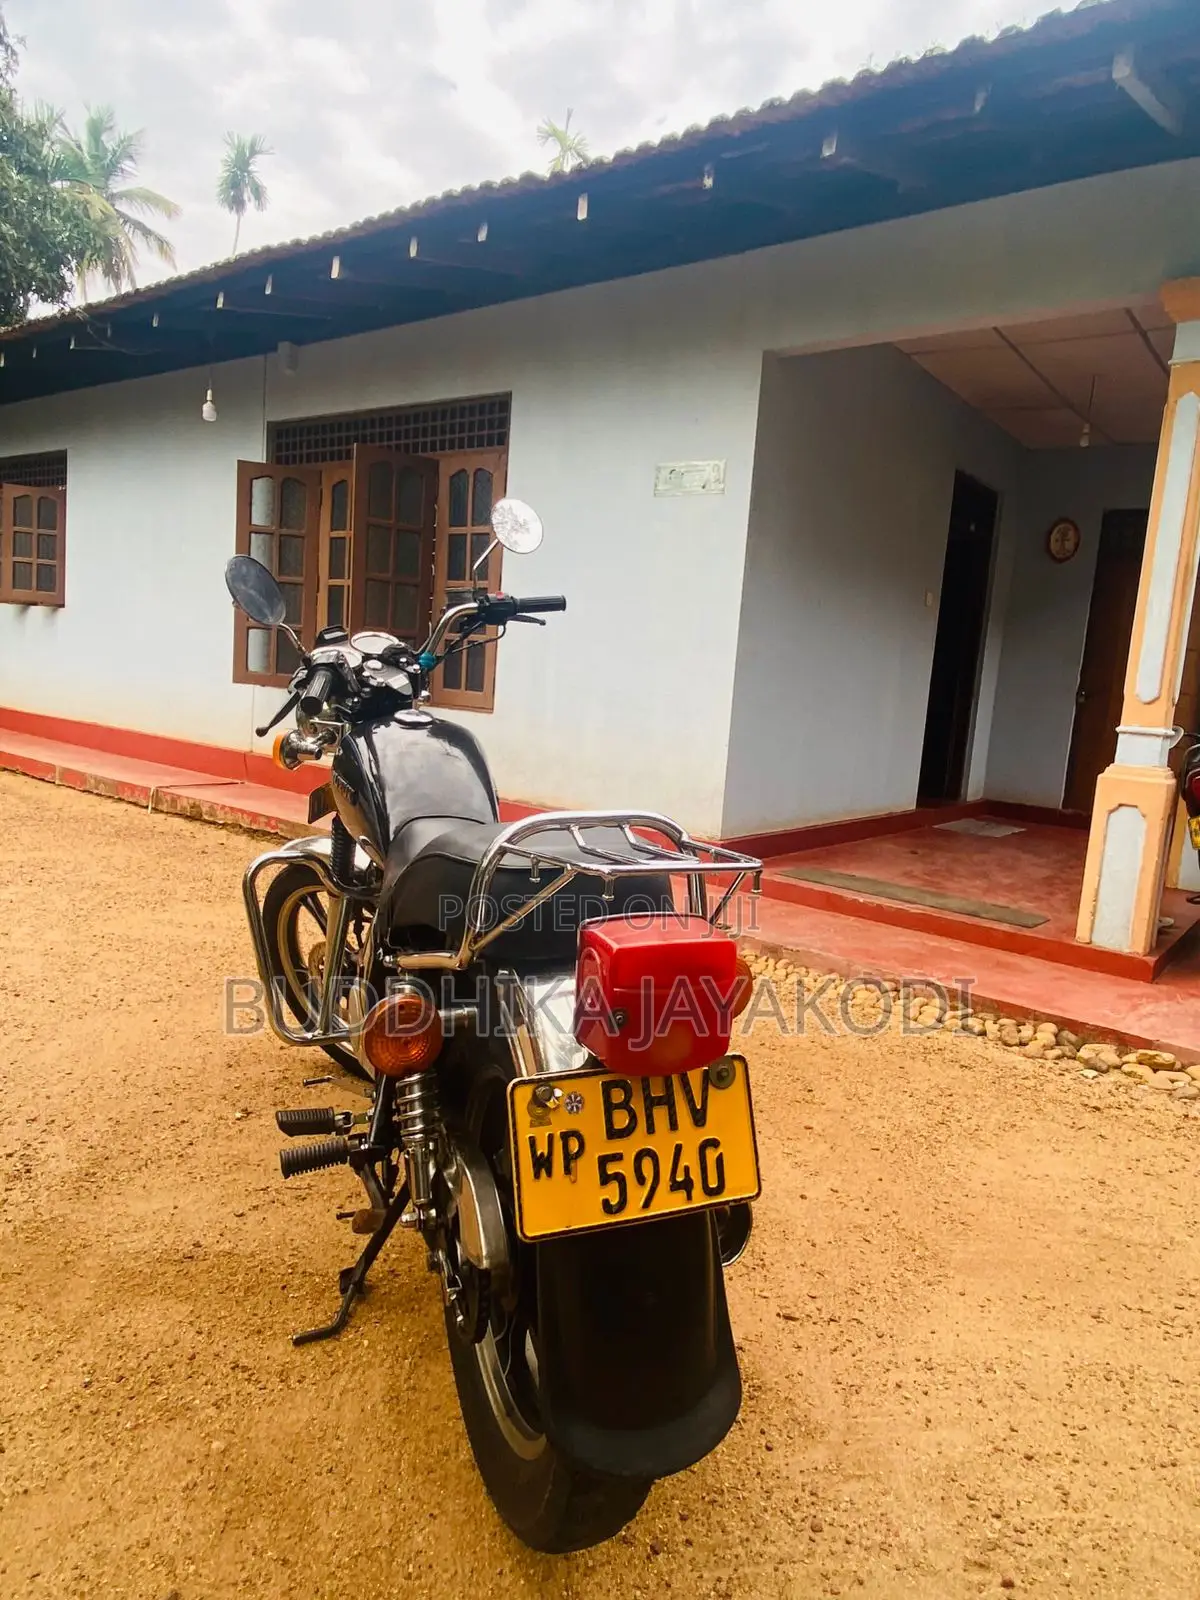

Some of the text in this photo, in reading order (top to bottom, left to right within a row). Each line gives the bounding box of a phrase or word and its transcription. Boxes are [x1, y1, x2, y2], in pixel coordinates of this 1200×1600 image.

[601, 1067, 711, 1140] BHV
[527, 1130, 585, 1180] WP
[597, 1138, 726, 1215] 5940
